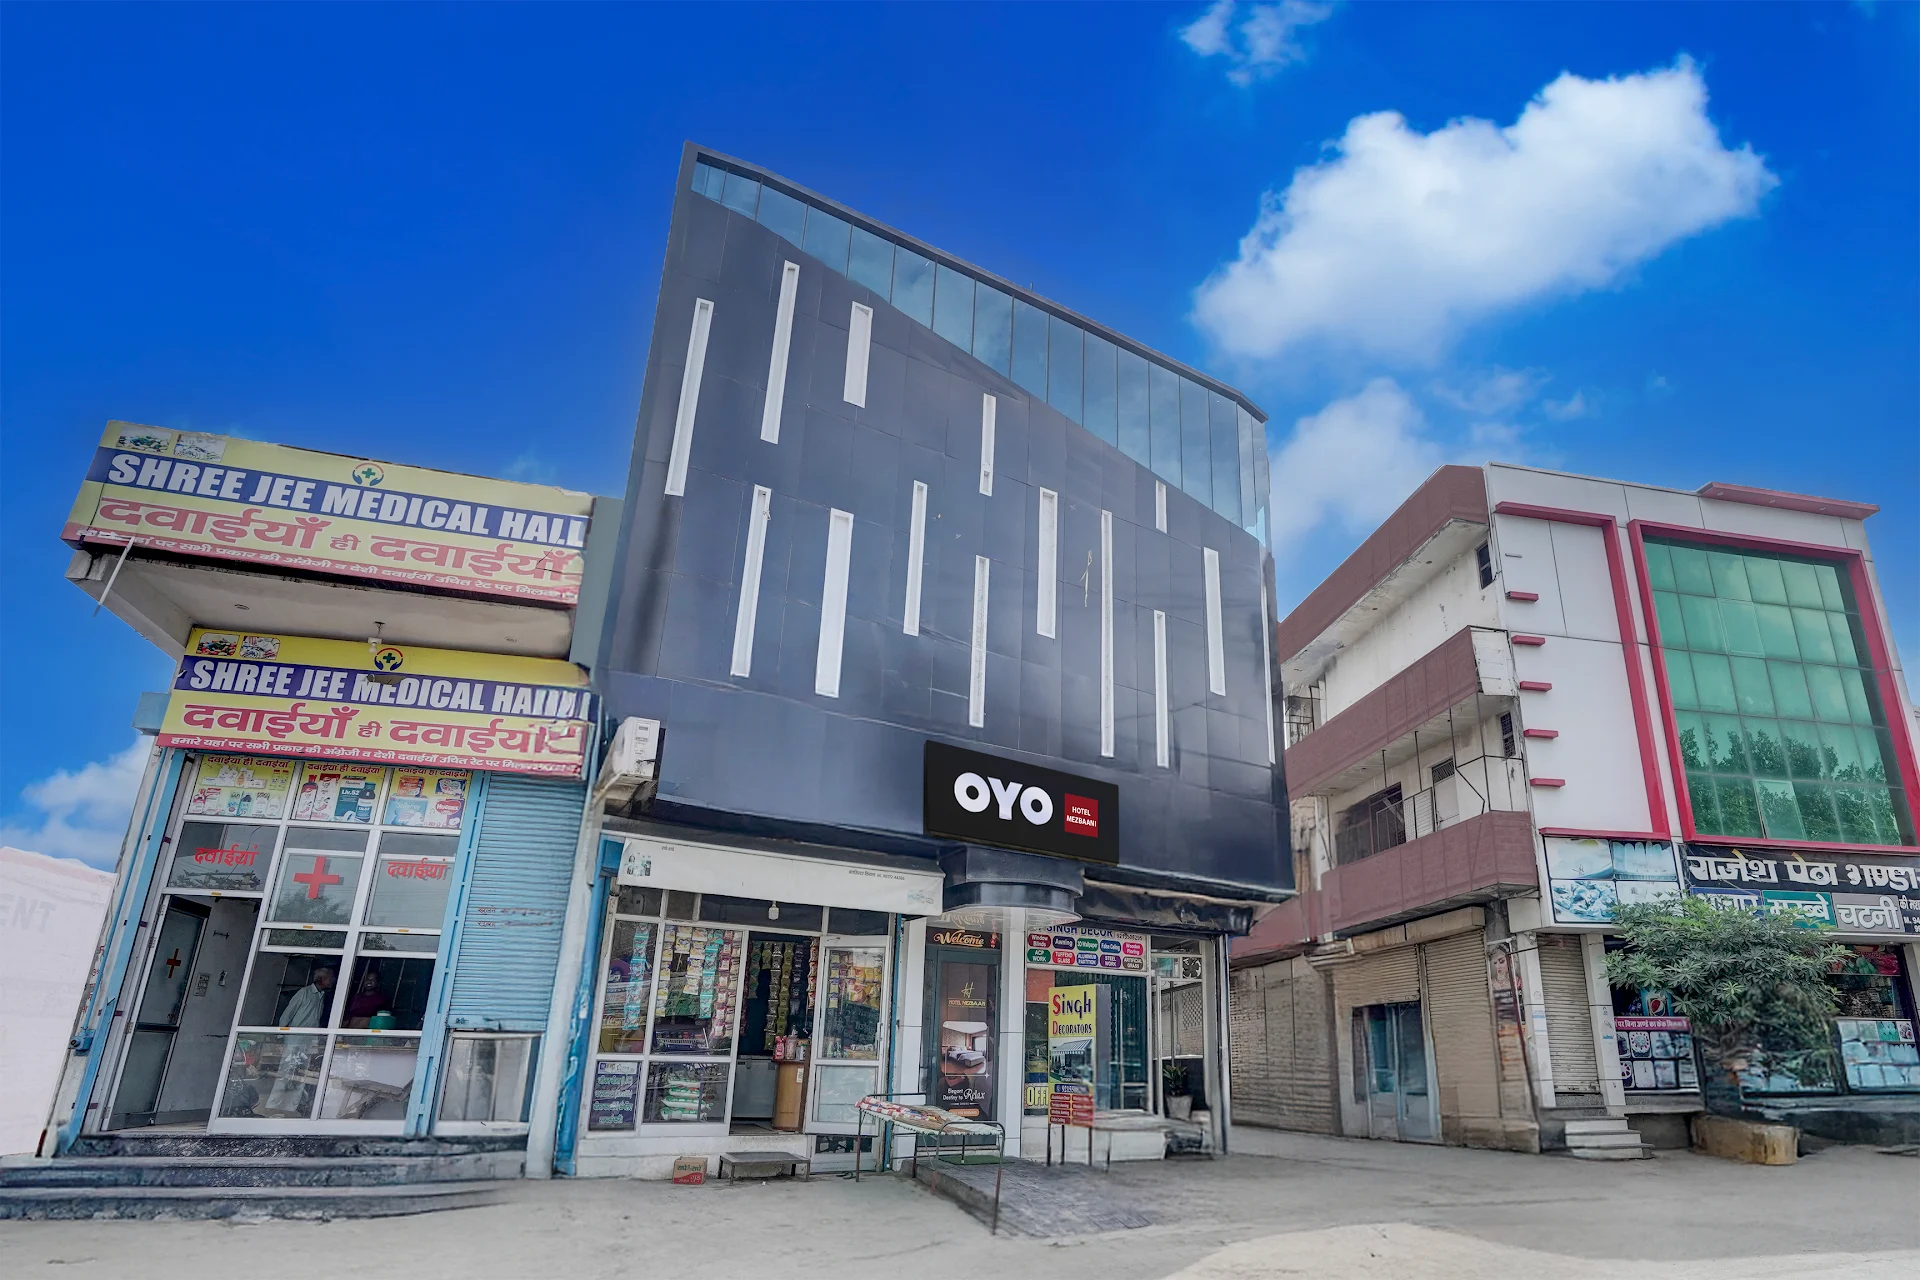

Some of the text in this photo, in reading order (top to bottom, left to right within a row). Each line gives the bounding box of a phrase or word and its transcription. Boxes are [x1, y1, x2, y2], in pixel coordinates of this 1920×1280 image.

[108, 454, 584, 548] SHREE JEE MEDICAL HALL
[329, 533, 361, 551] ही
[189, 660, 295, 695] SHREE
[296, 669, 348, 699] JEE
[351, 674, 484, 712] MEDICAL
[357, 721, 383, 738] ही
[171, 736, 202, 746] हमारे
[228, 741, 245, 749] पर
[246, 741, 271, 751] सभी
[305, 745, 322, 754] की
[953, 772, 1054, 826] OYO
[1071, 806, 1091, 817] HOTEL
[1066, 815, 1097, 828] MEZBAANI
[194, 844, 259, 867] दवाईयां
[387, 858, 449, 880] दवाईयां
[1686, 849, 1920, 892] राजेश पेठा भण्डा
[1836, 896, 1900, 930] चटनी
[933, 929, 985, 948] Welcome
[1080, 928, 1113, 937] DECOR
[963, 1088, 986, 1101] Relax
[1026, 1086, 1048, 1106] OFF
